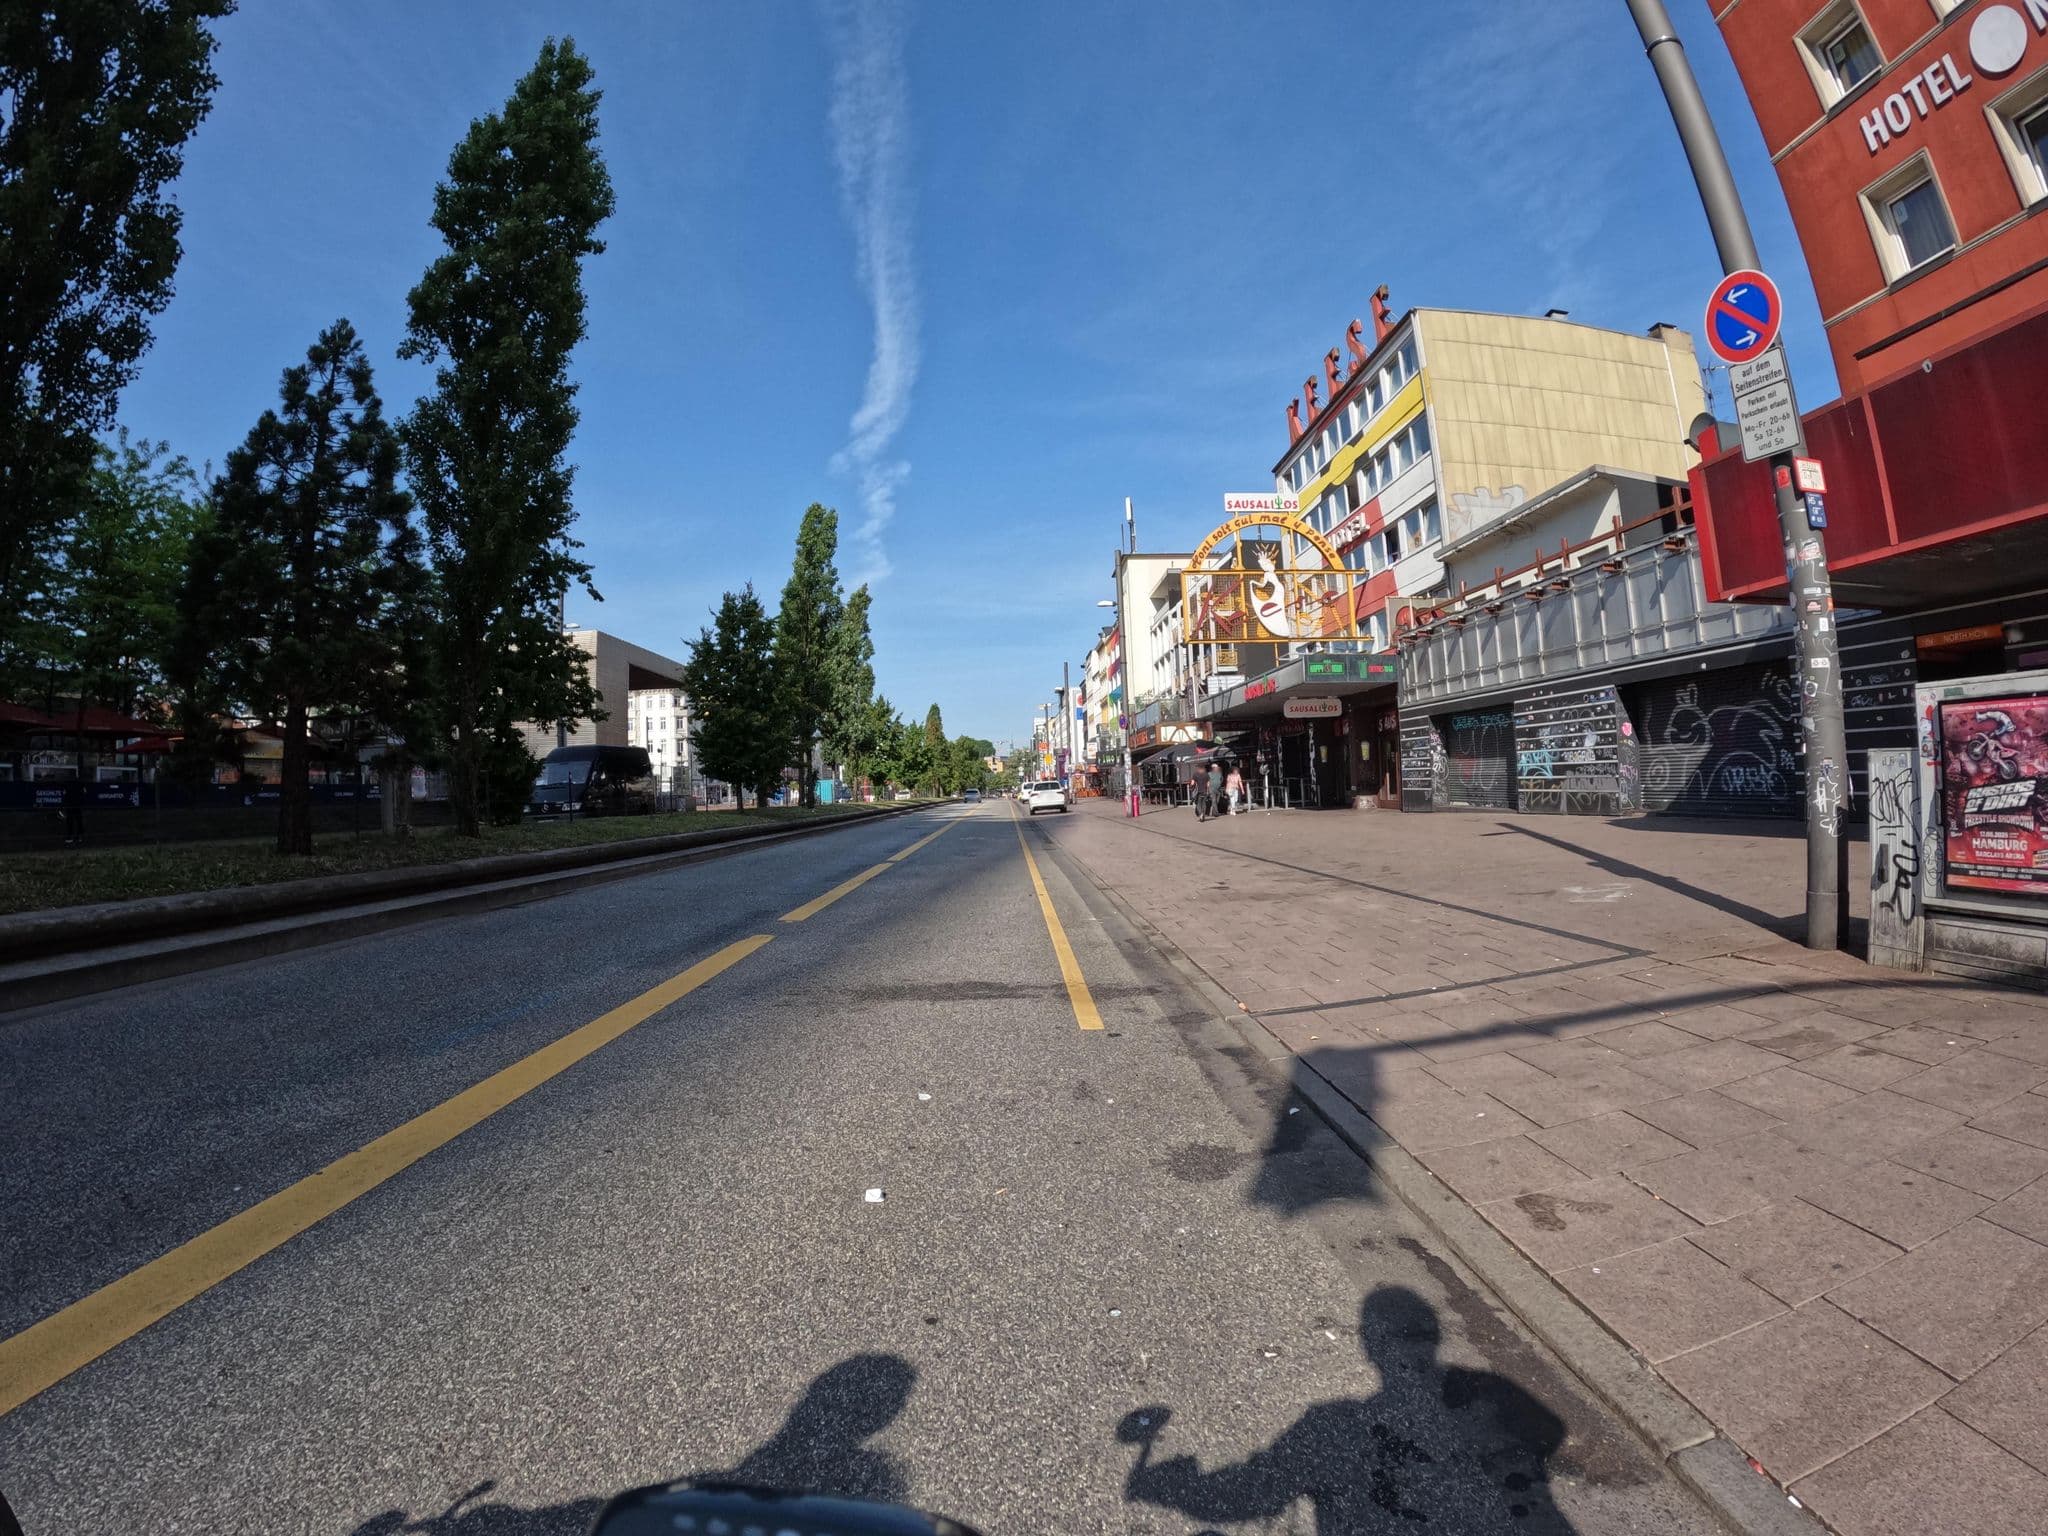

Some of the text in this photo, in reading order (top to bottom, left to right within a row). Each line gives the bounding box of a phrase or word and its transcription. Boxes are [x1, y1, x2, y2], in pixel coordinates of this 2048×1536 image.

[1859, 53, 1973, 153] HOTEL
[1742, 360, 1770, 378] auf dem
[1735, 368, 1782, 393] Seitenstreifen
[1748, 390, 1777, 406] Parken mit
[1741, 398, 1788, 419] Parkschein erlaubt
[1744, 412, 1790, 433] Mo-Fr 20-6h
[1754, 425, 1785, 442] Sa 12-6h
[1758, 437, 1784, 451] und So
[1227, 496, 1298, 510] SAUSALITOS
[1192, 541, 1213, 569] Honi
[1213, 524, 1232, 541] soit
[1260, 514, 1288, 523] mal
[1306, 529, 1336, 559] pense
[1289, 703, 1338, 713] SAUSALITOS
[1967, 780, 2036, 799] MASTERS
[1964, 791, 2034, 813] OF DIRT
[1964, 813, 1997, 828] FREESTYLE
[1998, 814, 2034, 831] SHOWDOWN
[1972, 838, 2028, 851] HAMBURG
